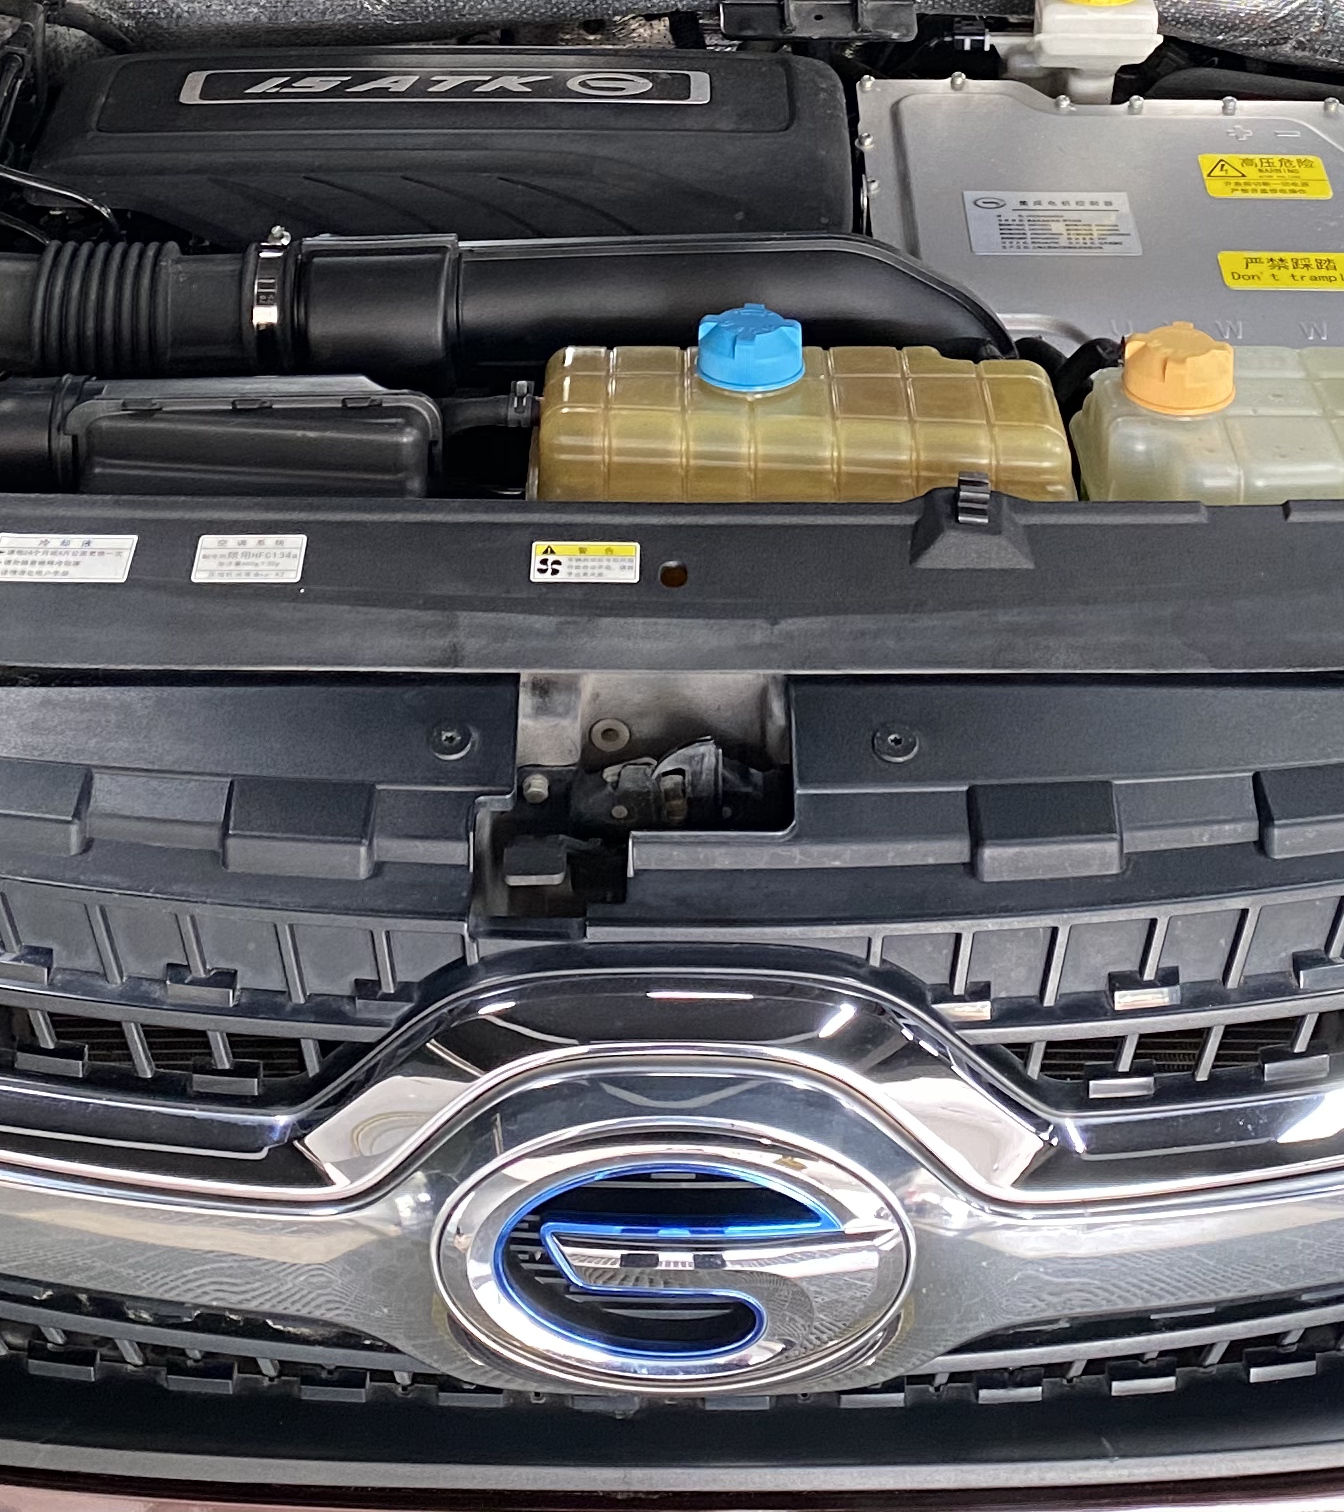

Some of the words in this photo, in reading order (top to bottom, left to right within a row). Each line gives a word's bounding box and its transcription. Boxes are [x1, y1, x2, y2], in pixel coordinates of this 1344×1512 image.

[1240, 158, 1315, 169] 高压危险
[1243, 256, 1338, 271] 严禁踩踏
[38, 539, 92, 547] 冷却液
